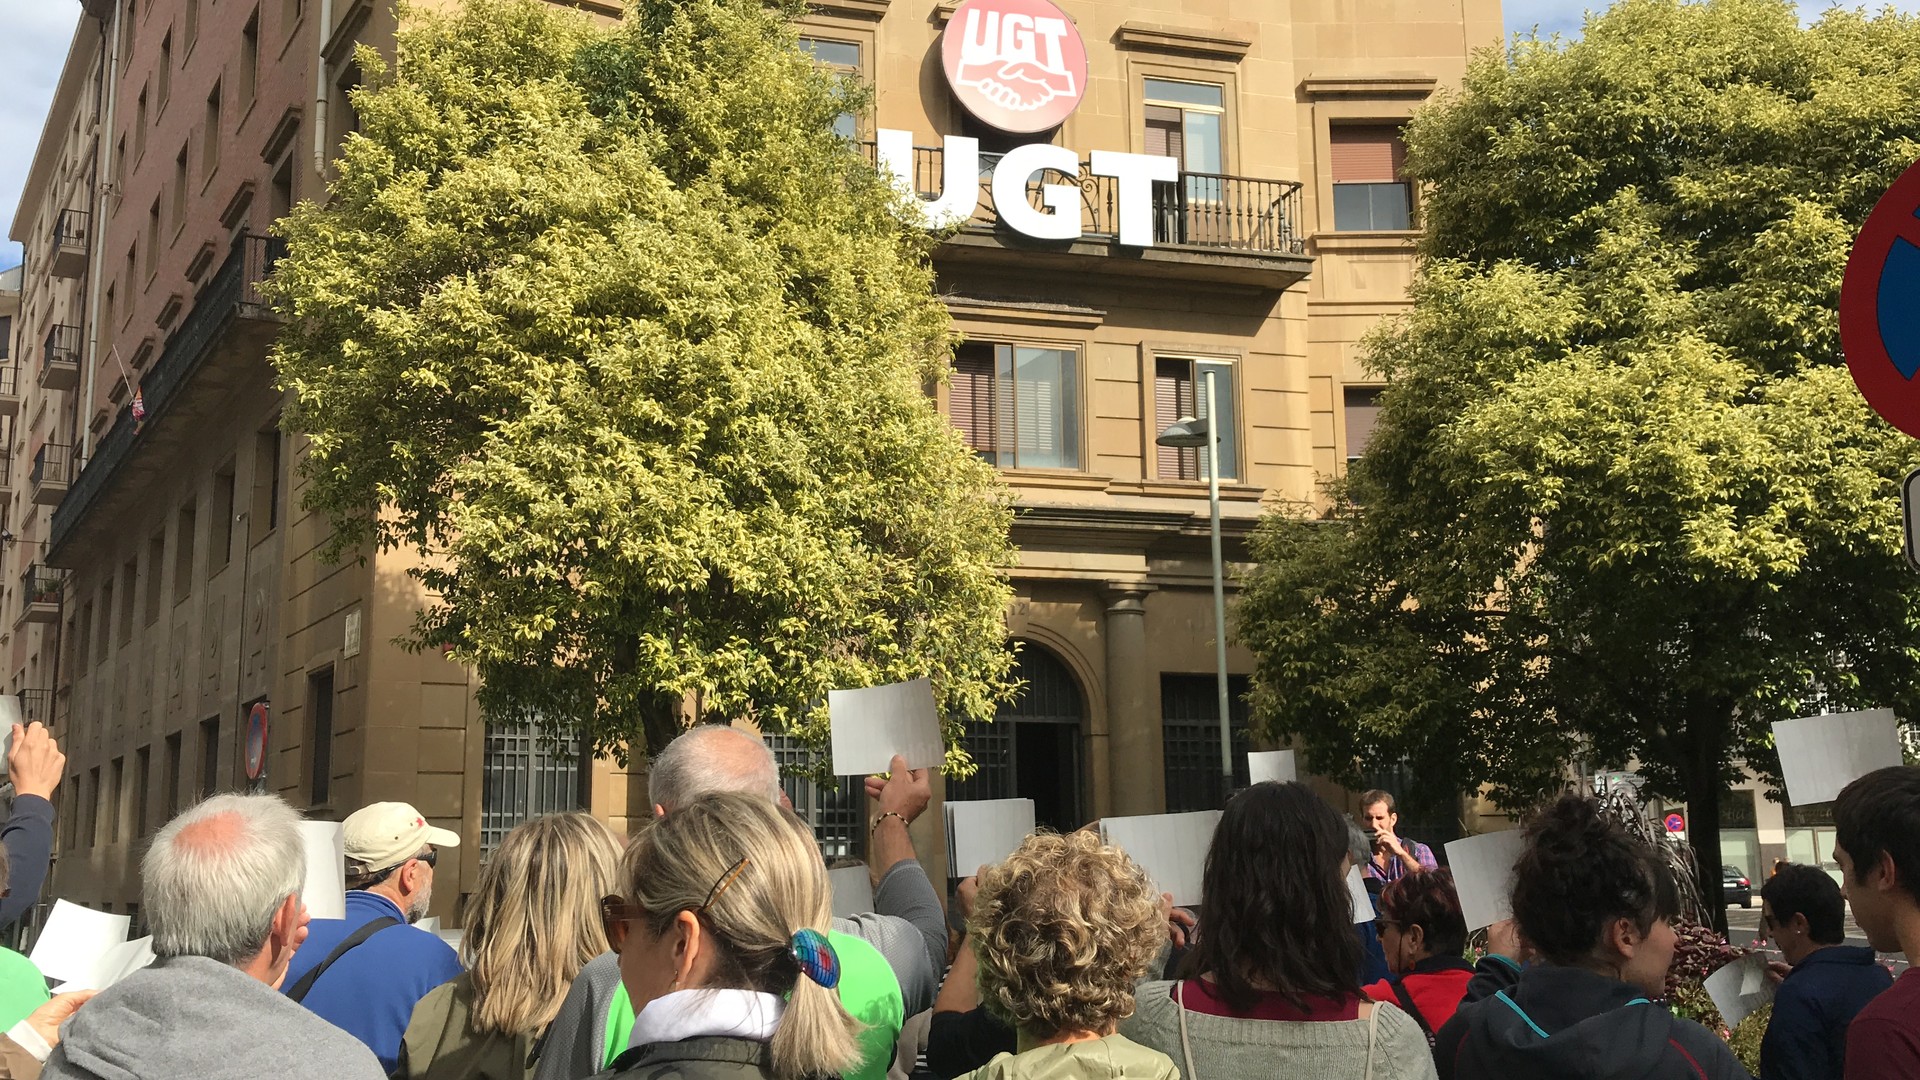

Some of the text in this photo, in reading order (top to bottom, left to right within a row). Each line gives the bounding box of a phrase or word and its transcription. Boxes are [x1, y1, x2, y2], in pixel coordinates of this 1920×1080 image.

[961, 8, 1068, 74] UGT
[877, 128, 1178, 247] UGT
[1008, 602, 1025, 616] 12
